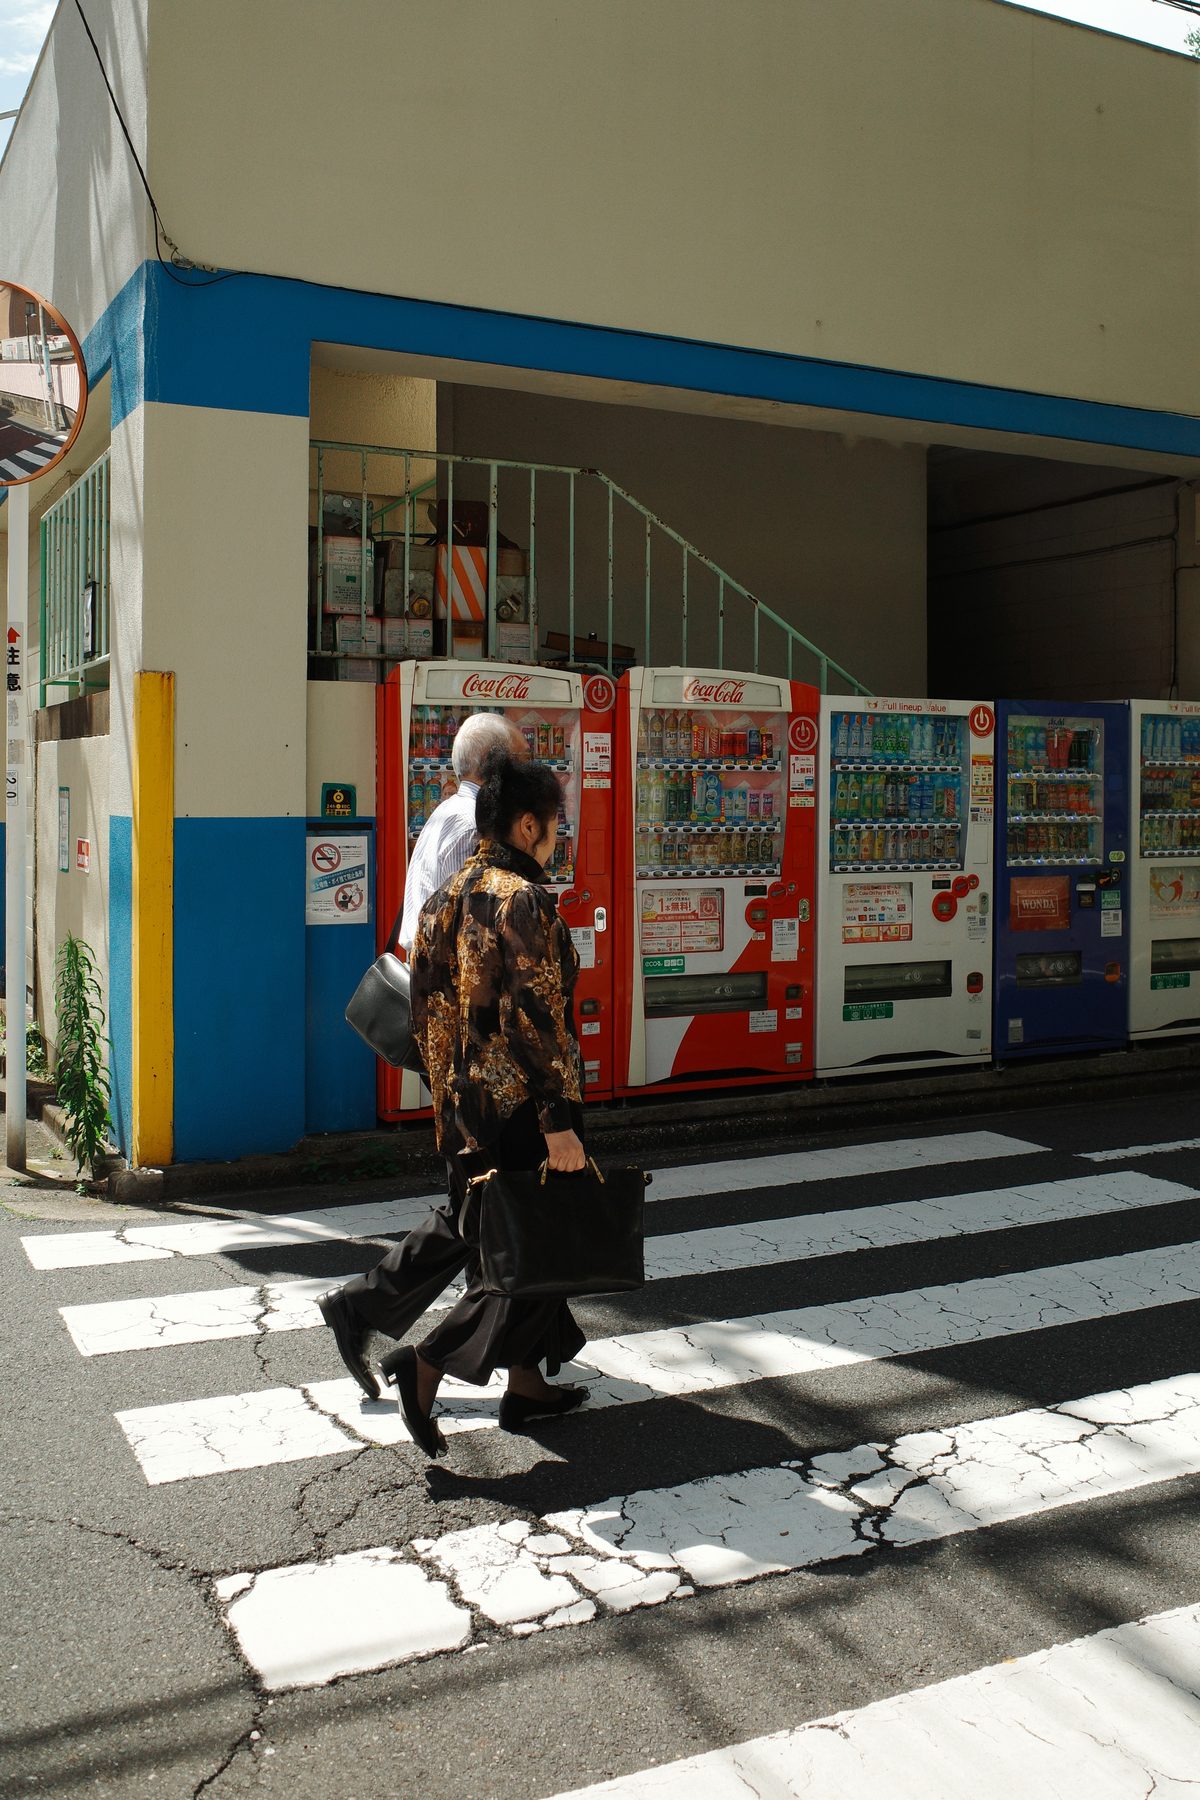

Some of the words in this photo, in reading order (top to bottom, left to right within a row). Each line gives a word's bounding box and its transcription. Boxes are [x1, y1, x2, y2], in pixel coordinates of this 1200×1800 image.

[462, 673, 535, 700] Coca-Cola
[684, 679, 748, 703] Coca-Cola
[898, 702, 923, 714] lineup
[658, 897, 692, 912] 1本無料!
[1022, 898, 1056, 910] WONDA
